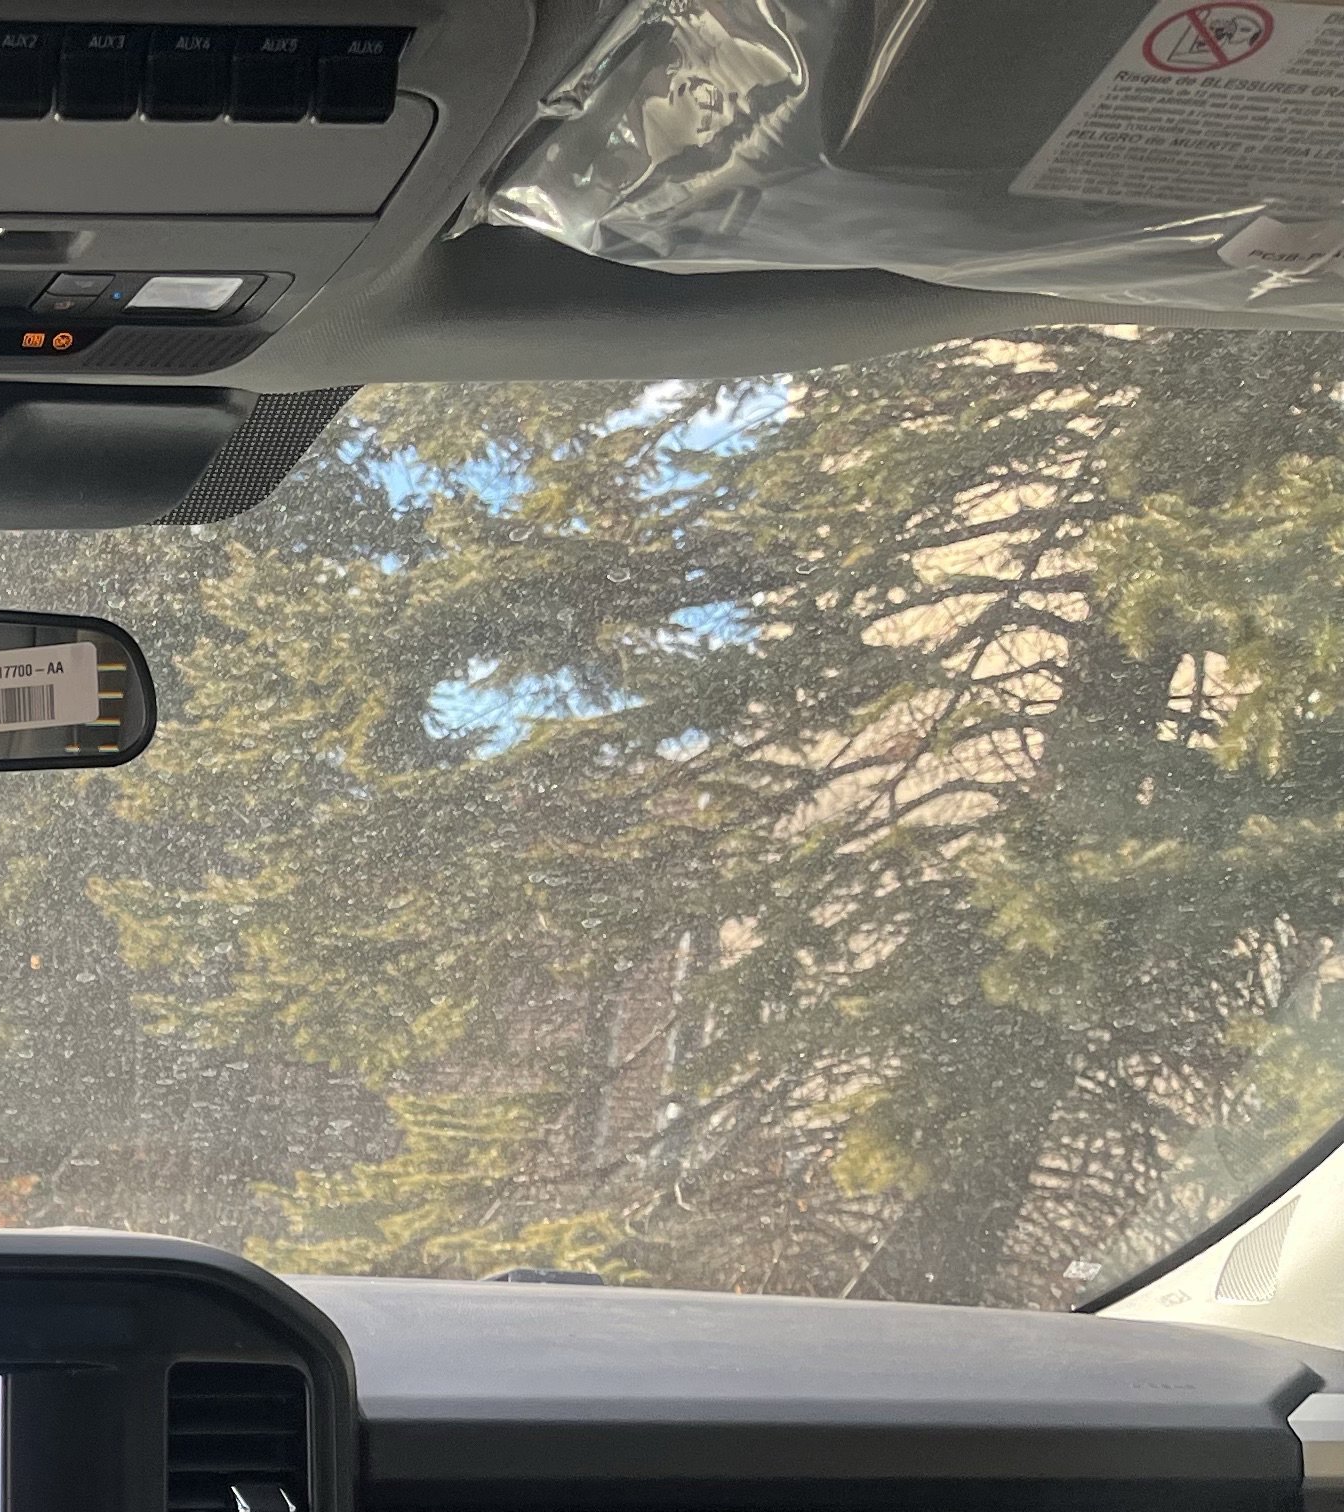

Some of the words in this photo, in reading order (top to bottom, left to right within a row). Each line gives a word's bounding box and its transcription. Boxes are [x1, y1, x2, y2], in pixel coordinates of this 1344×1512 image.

[2, 34, 38, 48] AUX2
[89, 35, 125, 49] AUX3
[175, 36, 210, 50] AUX4
[262, 38, 298, 52] AUX5
[348, 41, 384, 54] AUX6
[1114, 70, 1172, 86] Risque
[1175, 73, 1196, 86] de
[1200, 75, 1309, 96] BLESSURES
[1065, 128, 1142, 145] PELIGRO
[1168, 136, 1243, 150] MUERTE
